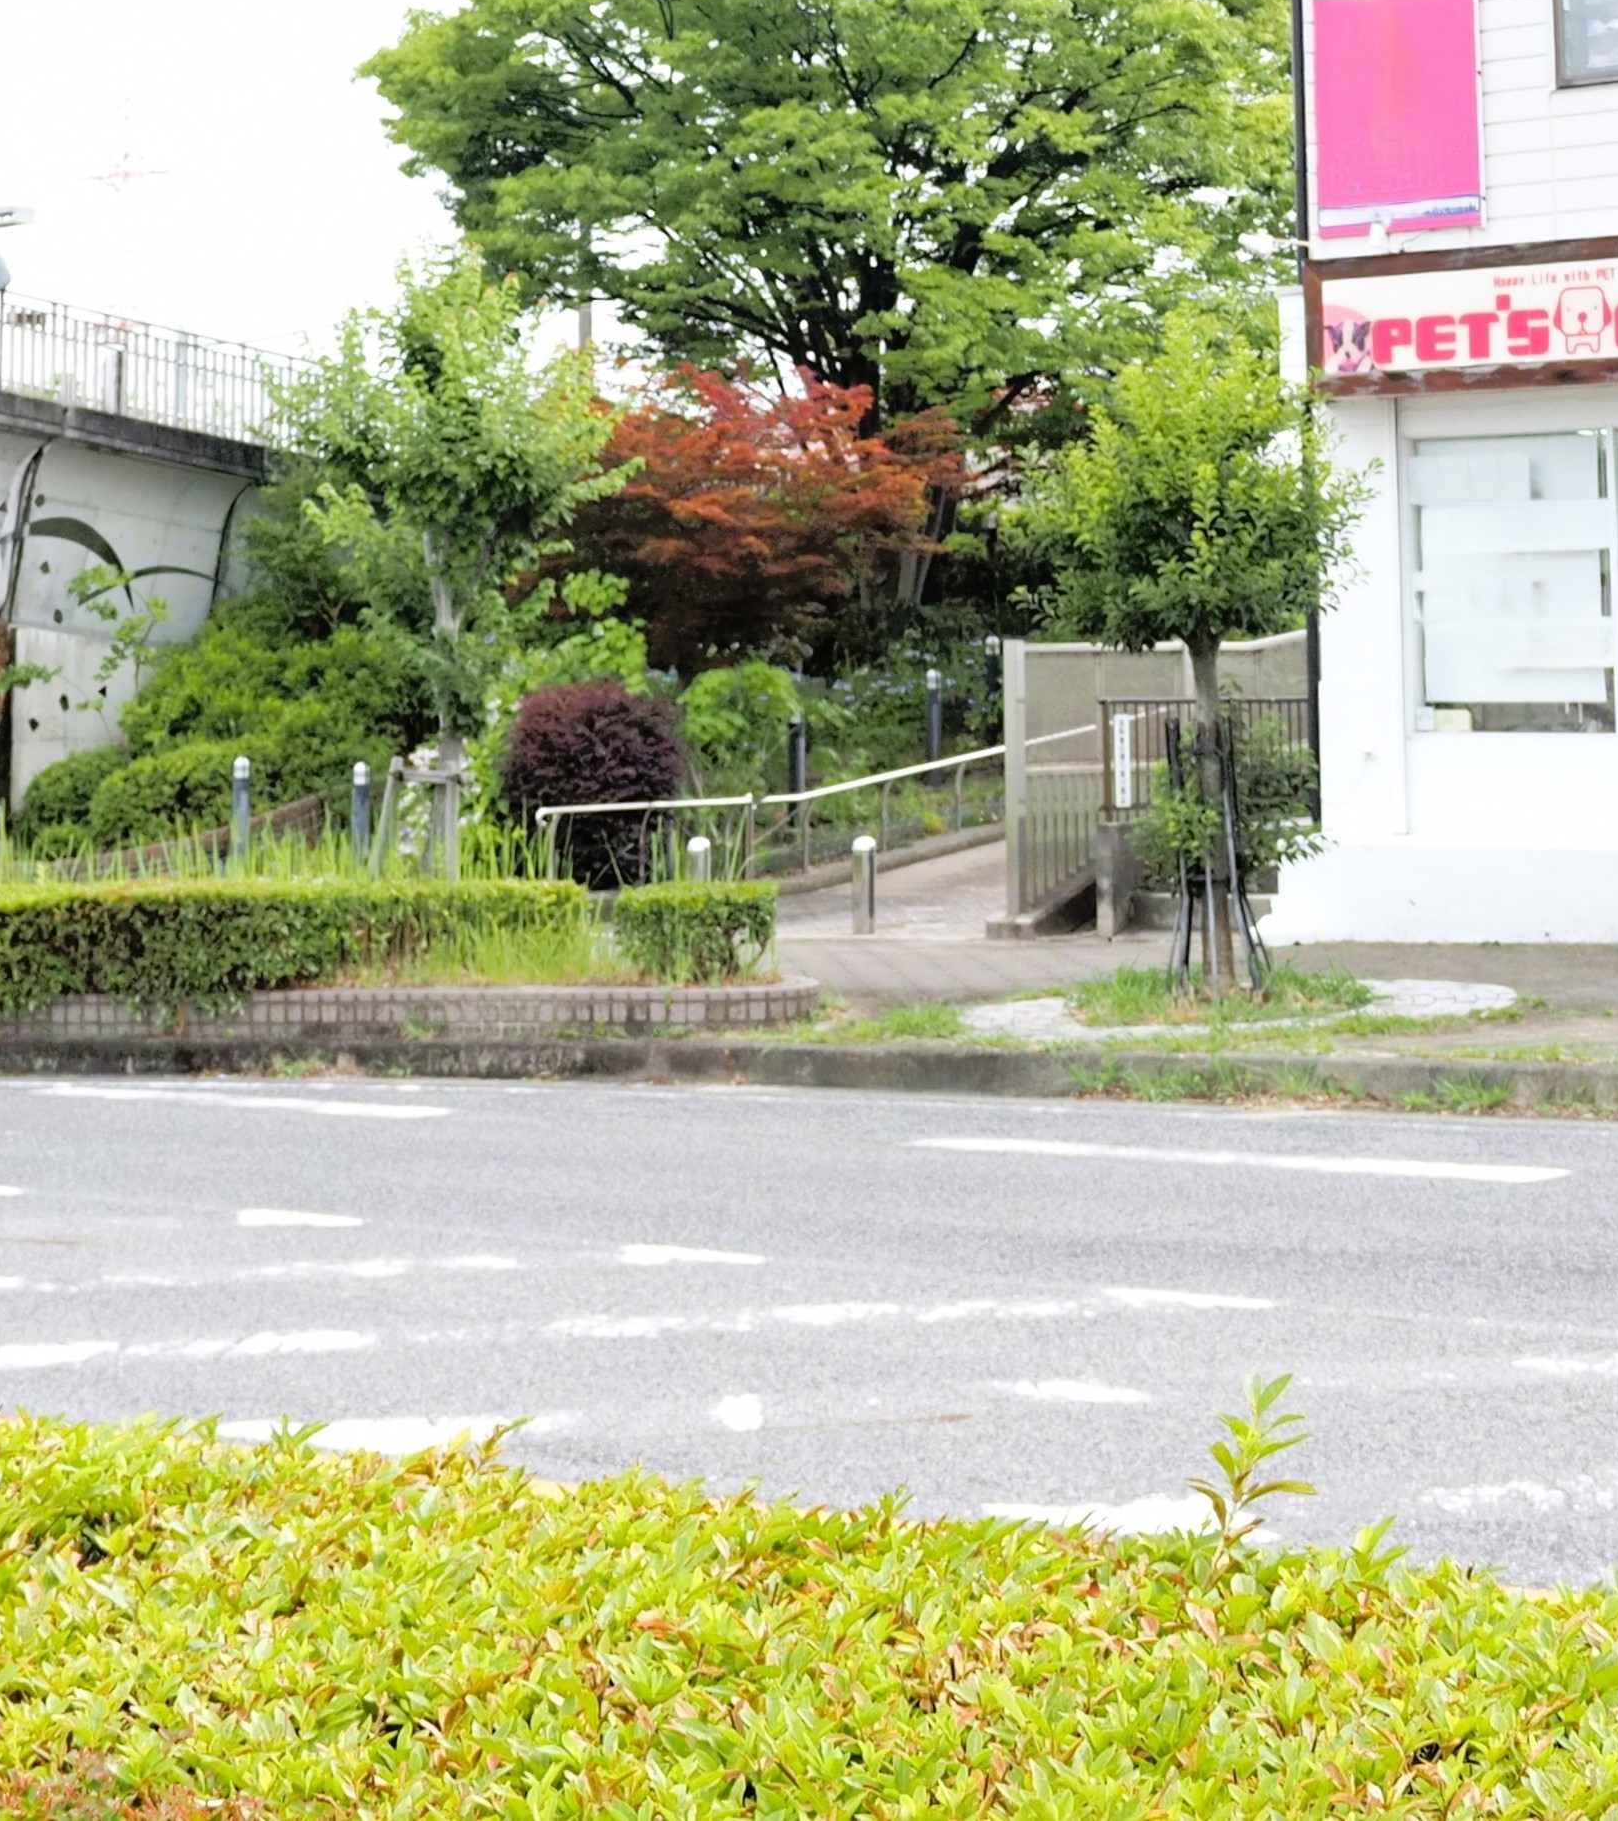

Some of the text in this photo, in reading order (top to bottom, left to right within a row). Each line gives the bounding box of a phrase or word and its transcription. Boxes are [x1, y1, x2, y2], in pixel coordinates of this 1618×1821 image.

[1532, 272, 1557, 286] Life
[1564, 269, 1590, 282] with
[1596, 267, 1615, 280] PET
[1371, 293, 1550, 365] PET'S
